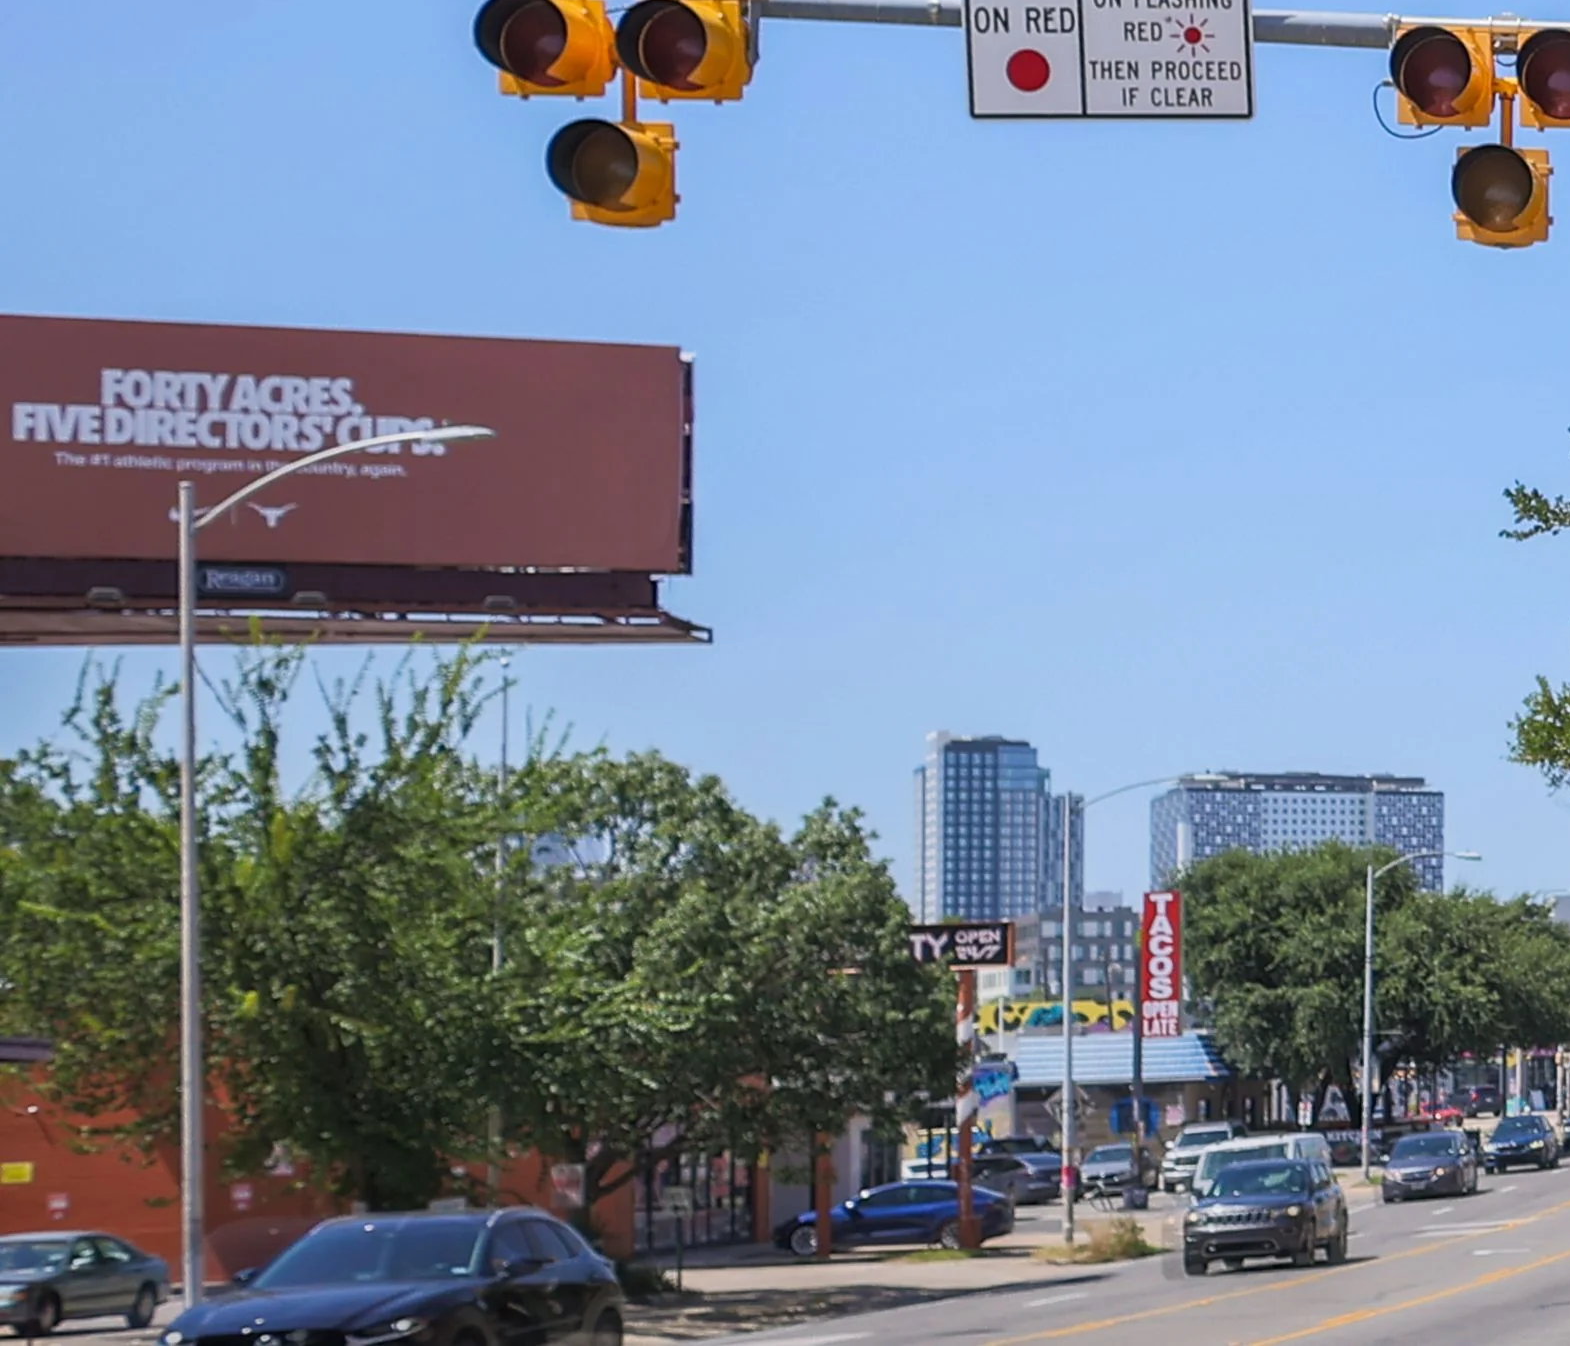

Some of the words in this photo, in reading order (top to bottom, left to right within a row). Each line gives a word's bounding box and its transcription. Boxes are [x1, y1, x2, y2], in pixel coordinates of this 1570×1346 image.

[974, 7, 1010, 34] ON
[1026, 7, 1075, 35] RED
[1123, 22, 1163, 42] RED
[1089, 61, 1140, 81] THEN
[1151, 61, 1242, 82] PROCEED
[1122, 88, 1139, 106] IF
[1151, 88, 1213, 107] CLEAR
[100, 367, 231, 411] FORTY
[230, 374, 366, 416] ACRES.
[12, 401, 102, 443] FIVE
[103, 406, 334, 452] DIRECTORS'
[54, 451, 85, 467] The
[90, 453, 111, 467] #1
[113, 453, 174, 471] athletic
[176, 458, 245, 475] program
[247, 459, 263, 472] in
[265, 459, 286, 472] th
[360, 464, 407, 479] again.
[909, 932, 948, 962] TY
[954, 929, 1001, 945] OPEN
[1148, 893, 1174, 999] TACOS
[1142, 1000, 1179, 1019] OPEN
[1142, 1018, 1179, 1037] LATE
